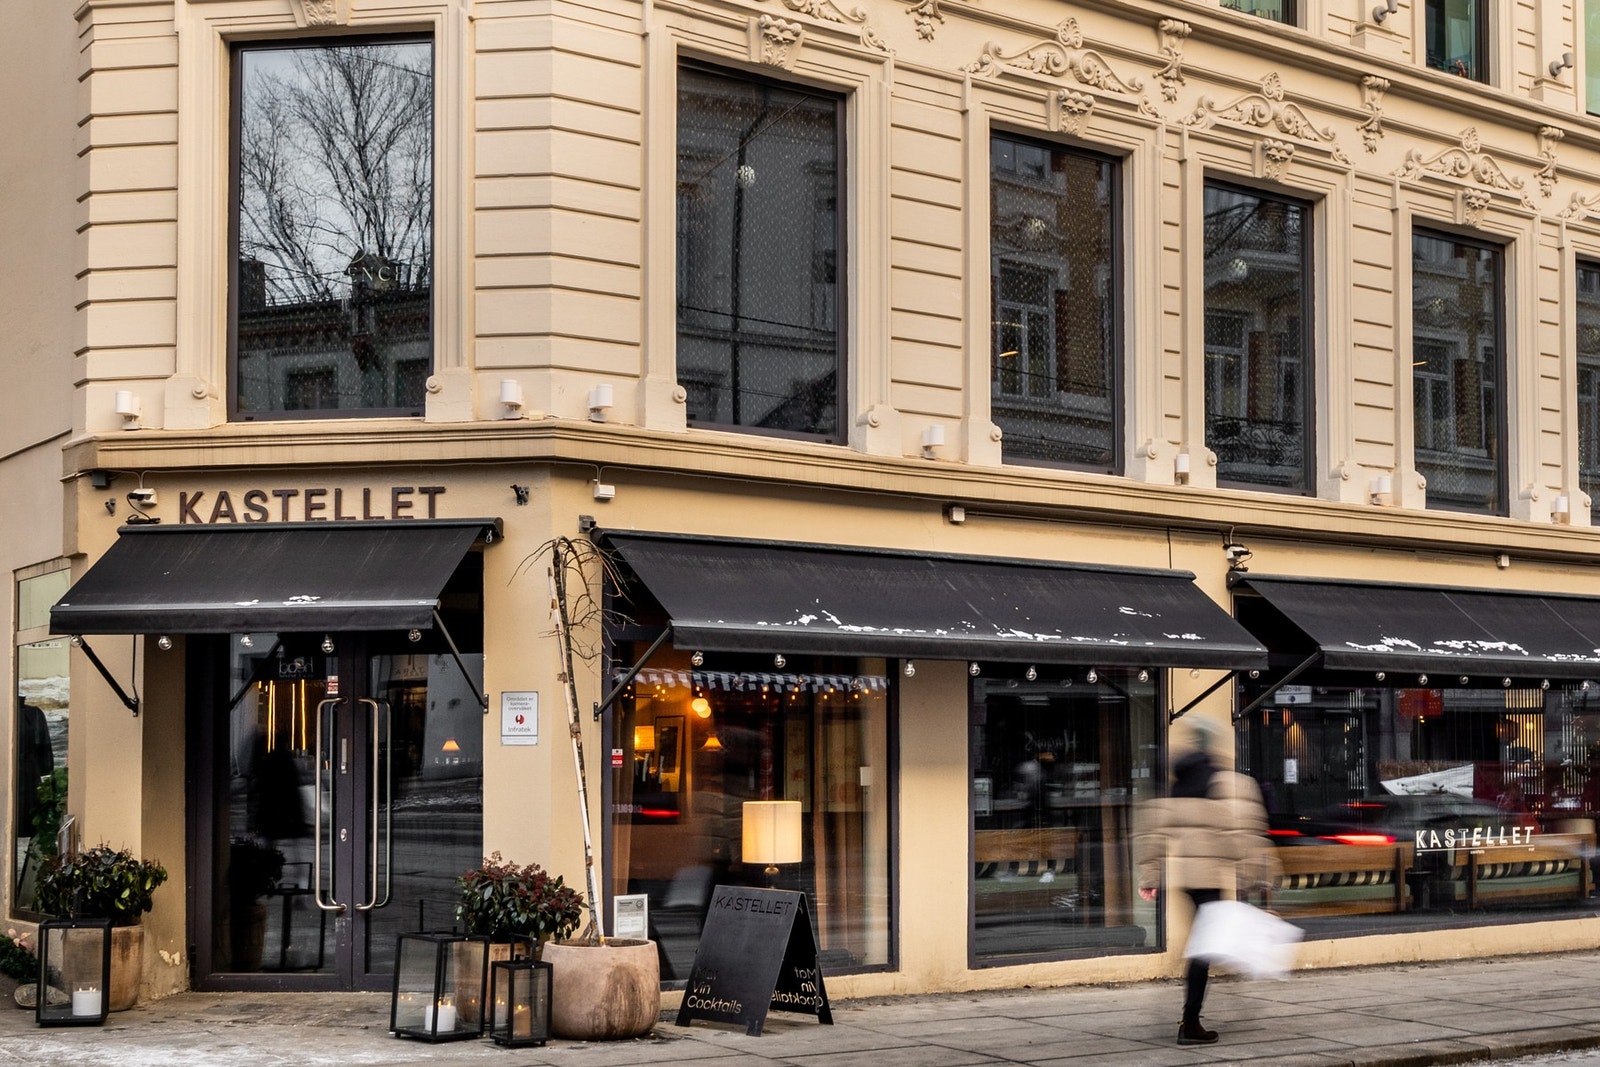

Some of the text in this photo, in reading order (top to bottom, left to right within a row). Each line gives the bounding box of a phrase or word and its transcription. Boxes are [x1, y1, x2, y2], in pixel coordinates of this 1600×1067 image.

[179, 486, 446, 525] KASTELLET
[1416, 826, 1535, 849] KASTELLET
[714, 896, 793, 915] KASTELLET
[692, 980, 711, 995] Vin
[687, 995, 743, 1015] Cocktails
